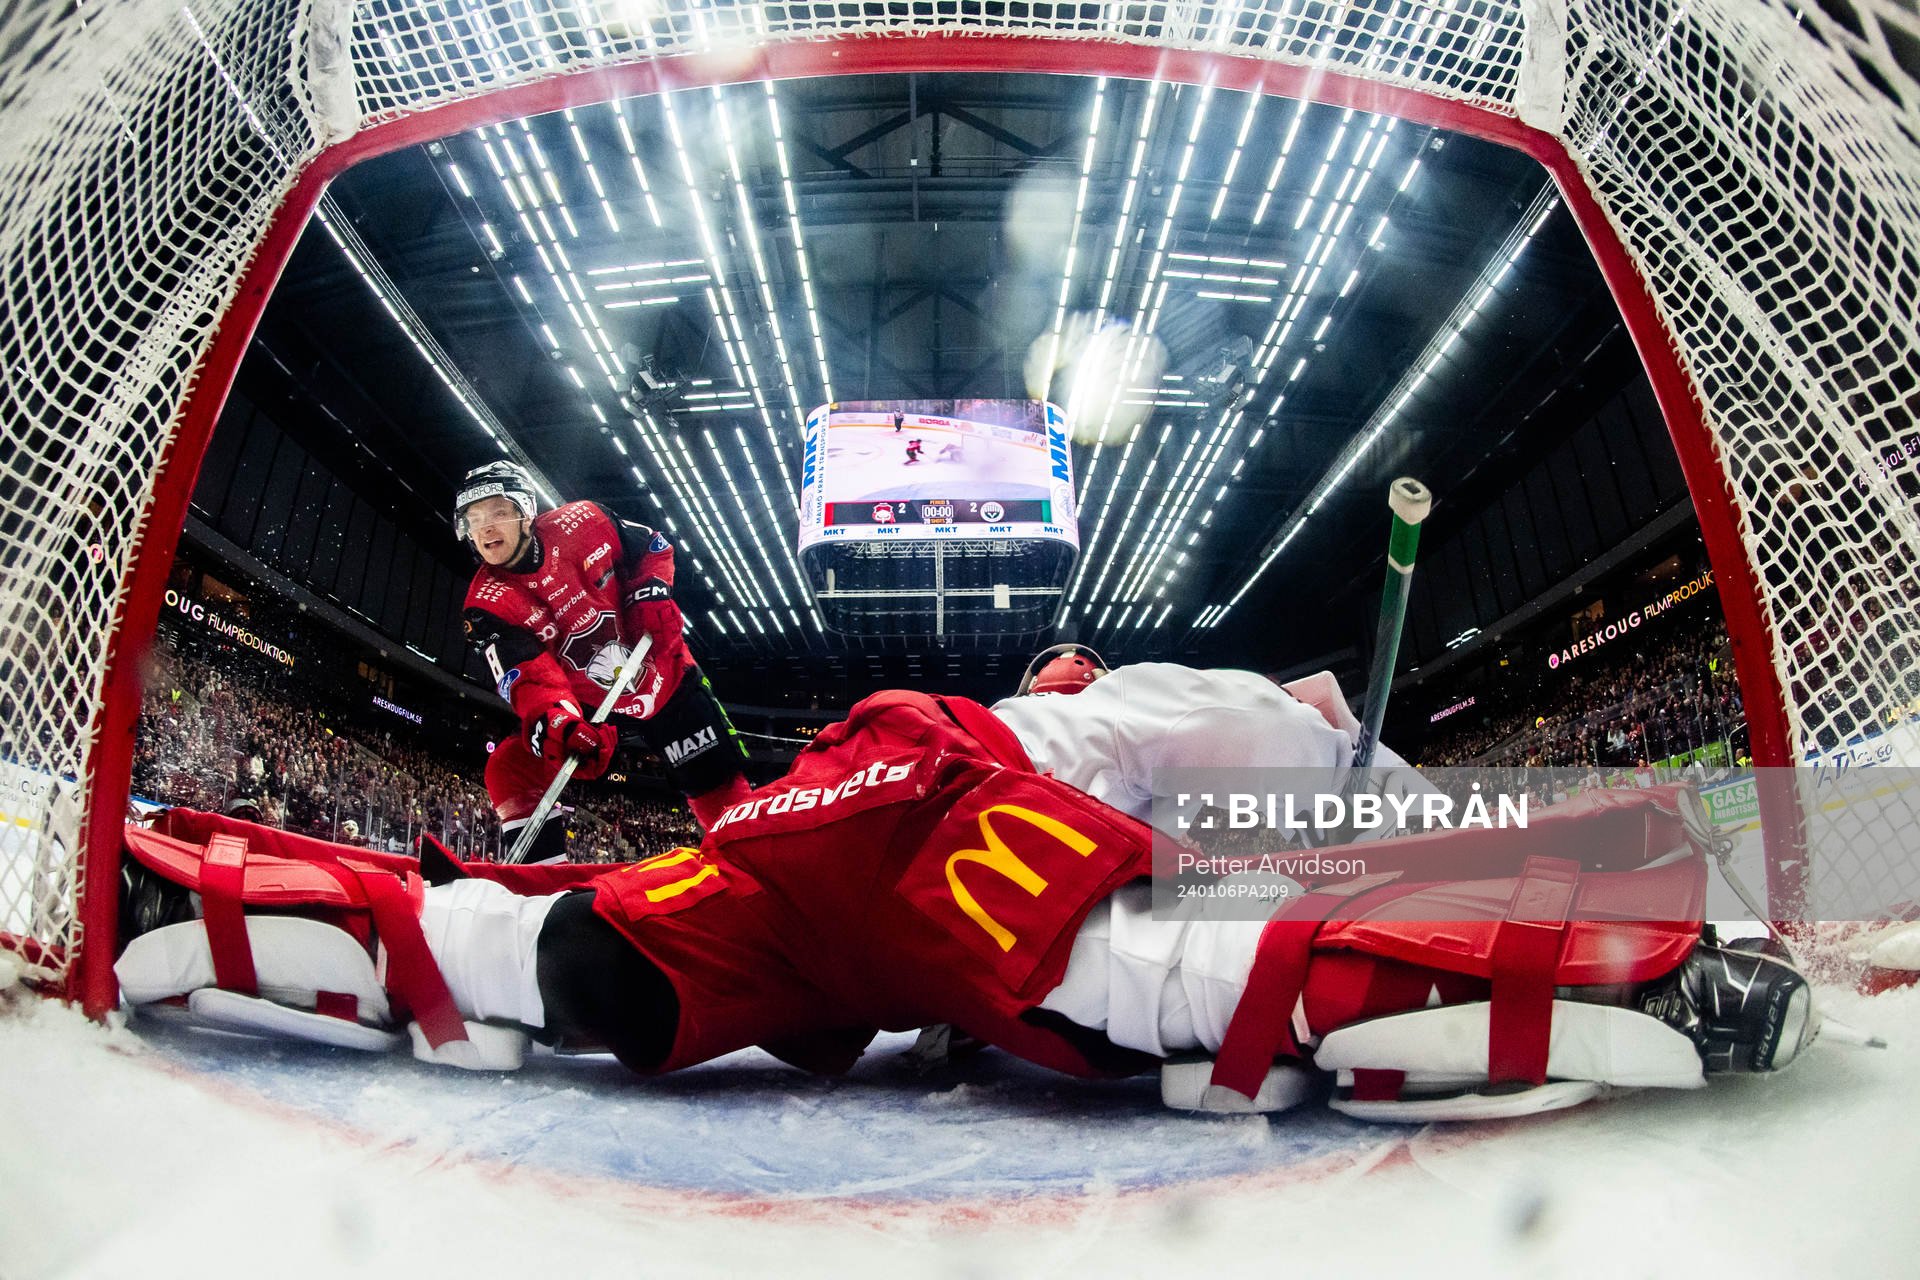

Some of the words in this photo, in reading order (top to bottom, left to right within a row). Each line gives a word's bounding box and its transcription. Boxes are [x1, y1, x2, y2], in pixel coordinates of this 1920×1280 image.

[918, 417, 950, 426] BORGA
[803, 417, 819, 489] MKT
[1047, 406, 1069, 483] MKT
[560, 506, 590, 530] ARENA
[898, 503, 906, 514] 2
[924, 506, 952, 517] 00:00
[970, 502, 977, 513] 2
[565, 510, 596, 535] HOTEL
[823, 528, 845, 536] MKT
[1044, 526, 1064, 534] MKT
[548, 583, 569, 601] CCM
[208, 613, 295, 668] FILMPRODUKTION
[1561, 611, 1642, 664] ARESKOUG
[372, 695, 422, 724] ARESKOUGFILM.SE
[1430, 696, 1476, 722] ARESKOUGFILM.SE
[663, 725, 718, 764] MAXI
